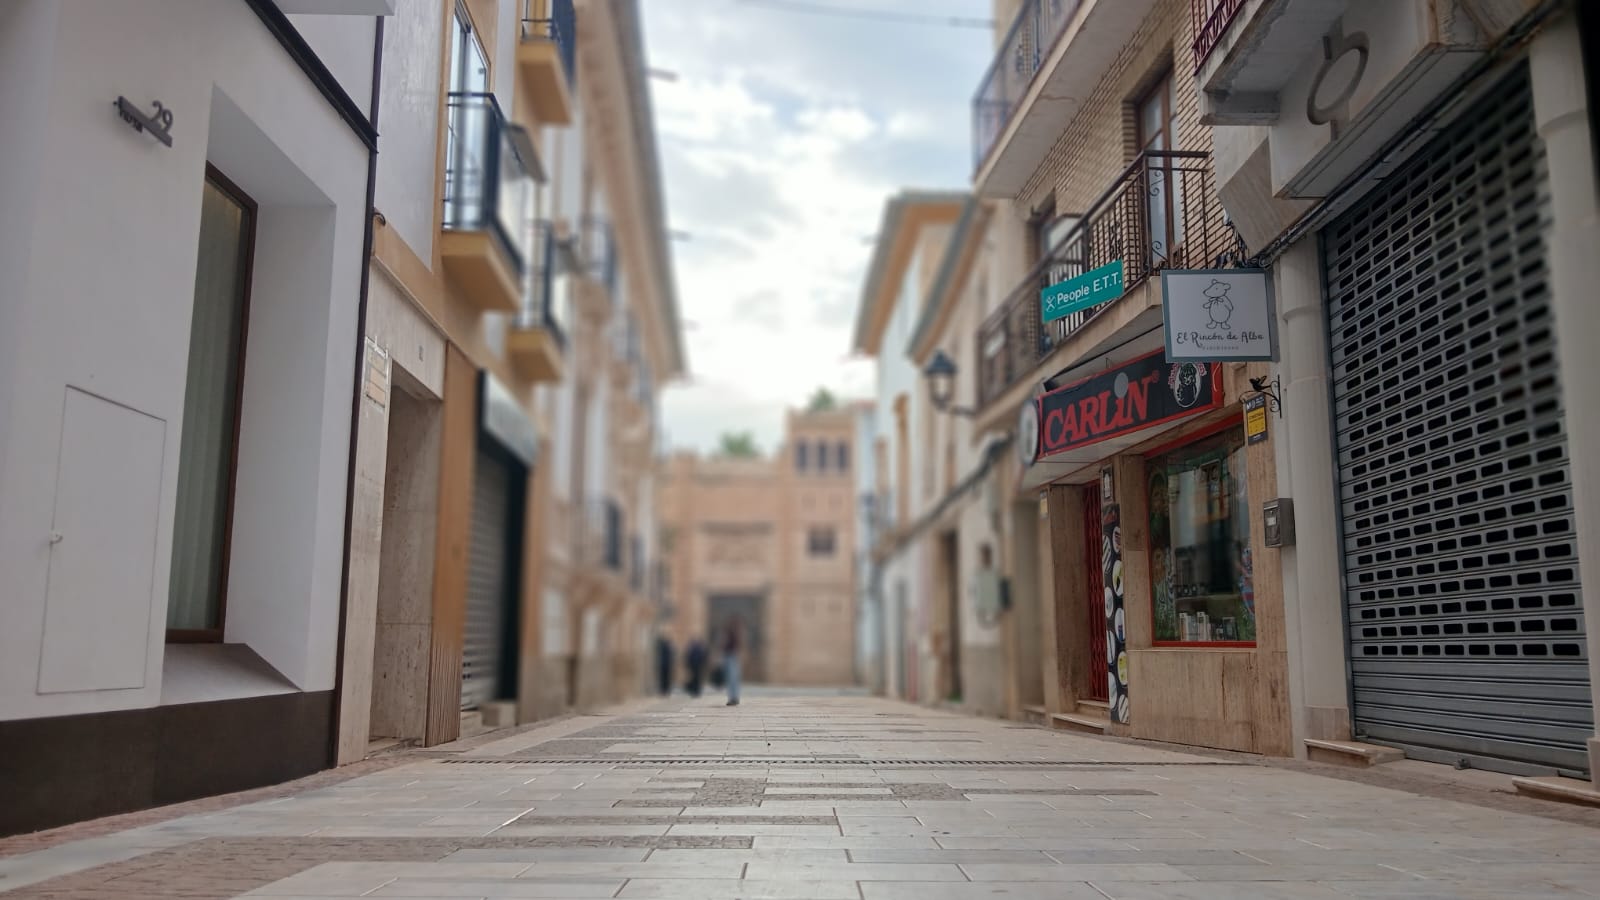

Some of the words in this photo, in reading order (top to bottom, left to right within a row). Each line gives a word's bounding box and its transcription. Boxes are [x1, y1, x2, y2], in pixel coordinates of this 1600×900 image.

[152, 100, 173, 131] 29
[1057, 285, 1090, 305] People
[1093, 271, 1122, 293] E.T.T.
[1176, 332, 1188, 344] El
[1190, 331, 1225, 348] Rincón
[1226, 331, 1239, 340] de
[1241, 331, 1265, 344] Alba
